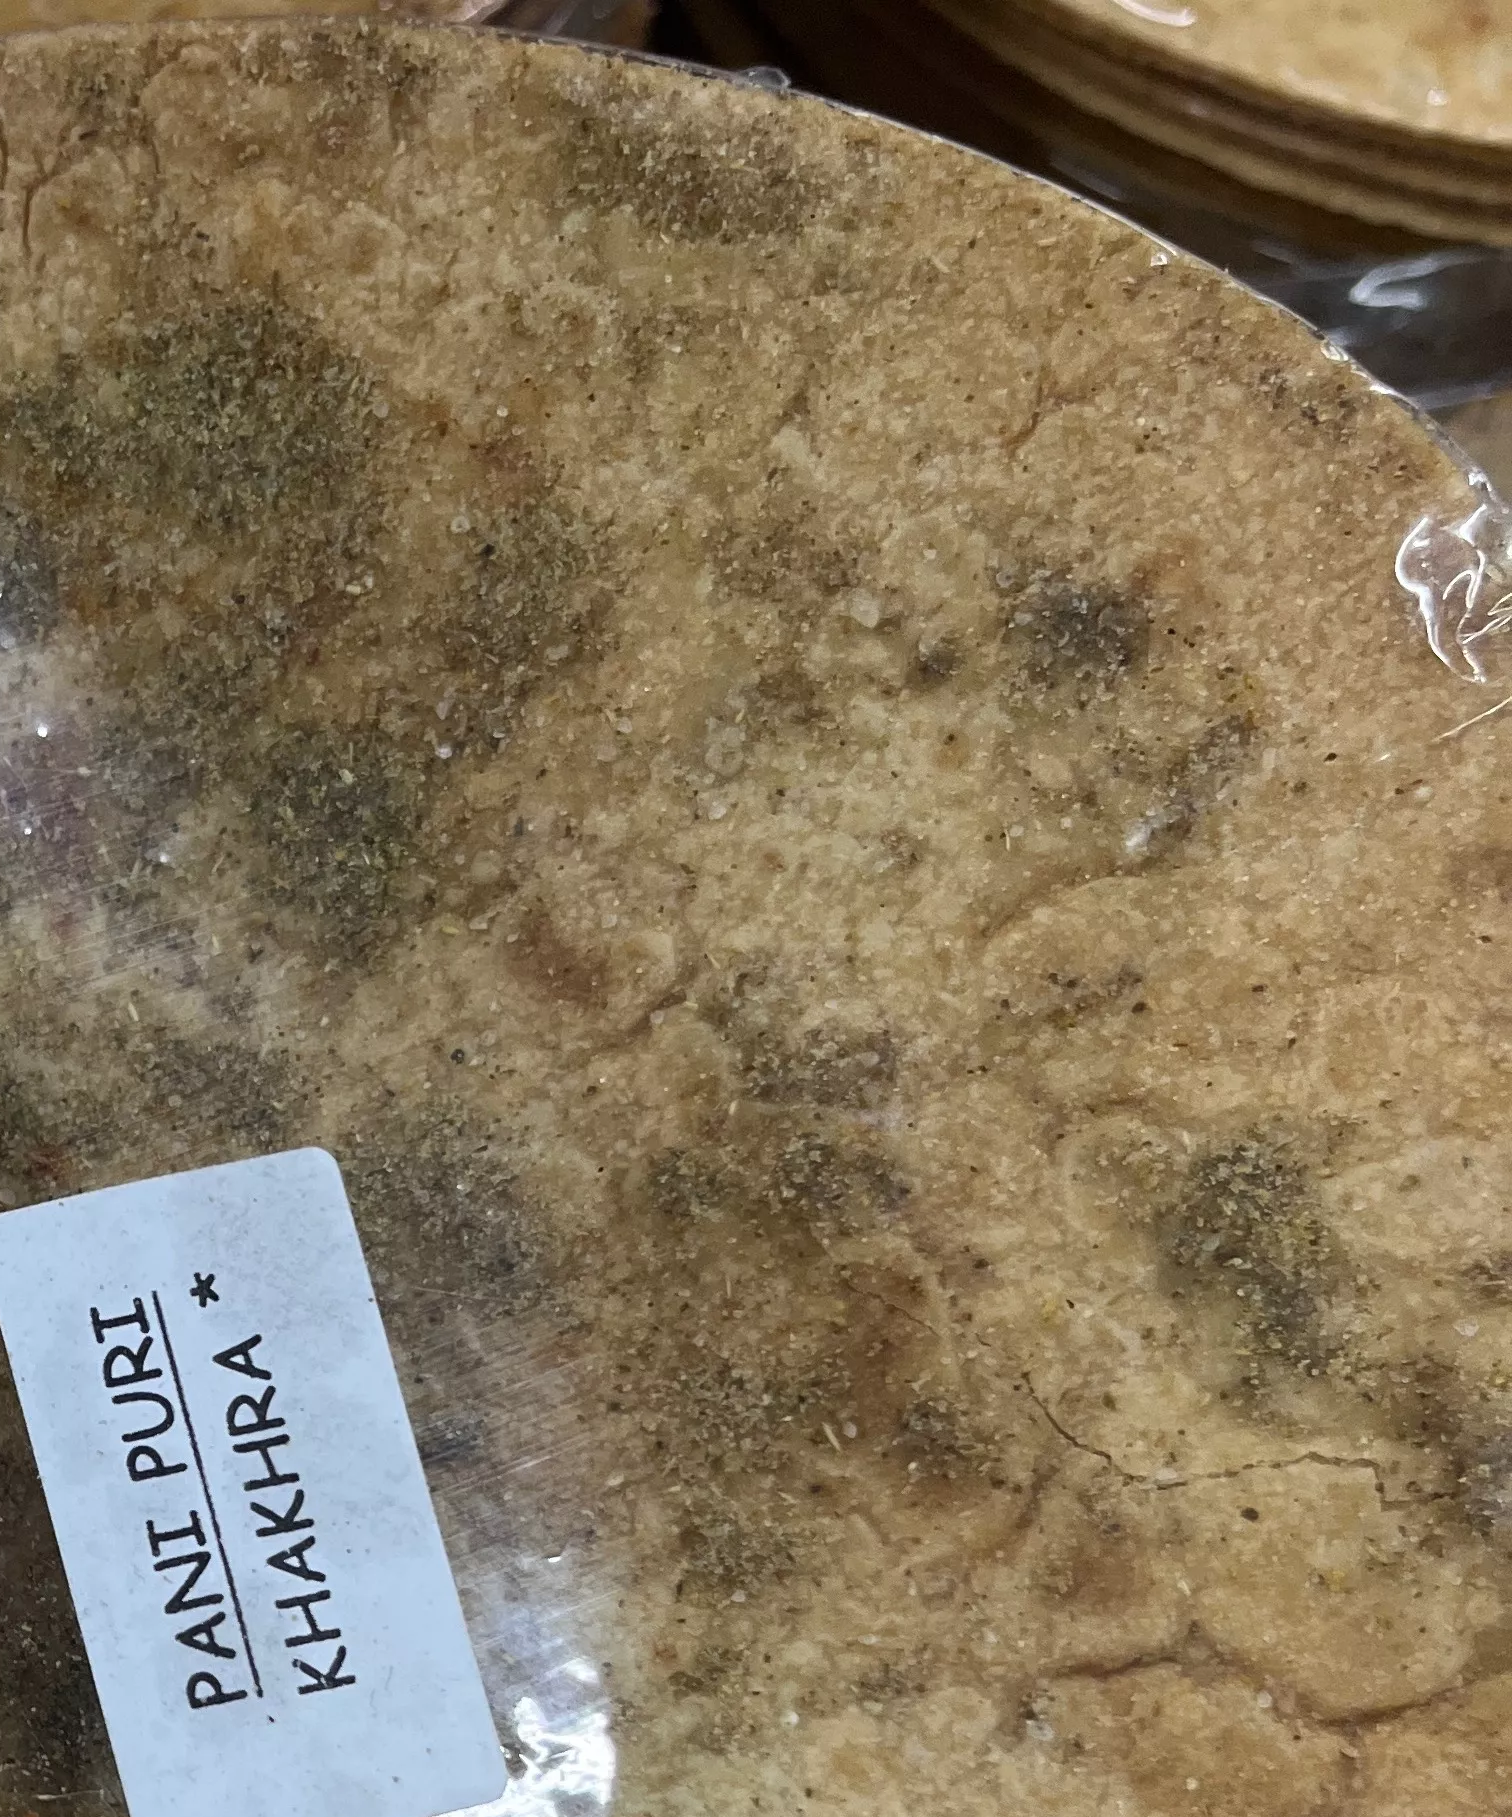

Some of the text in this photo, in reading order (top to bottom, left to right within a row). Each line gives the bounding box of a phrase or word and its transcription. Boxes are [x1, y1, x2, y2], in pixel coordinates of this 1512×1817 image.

[90, 1296, 249, 1711] PANI PURI
[212, 1334, 357, 1696] KHAKHRA
